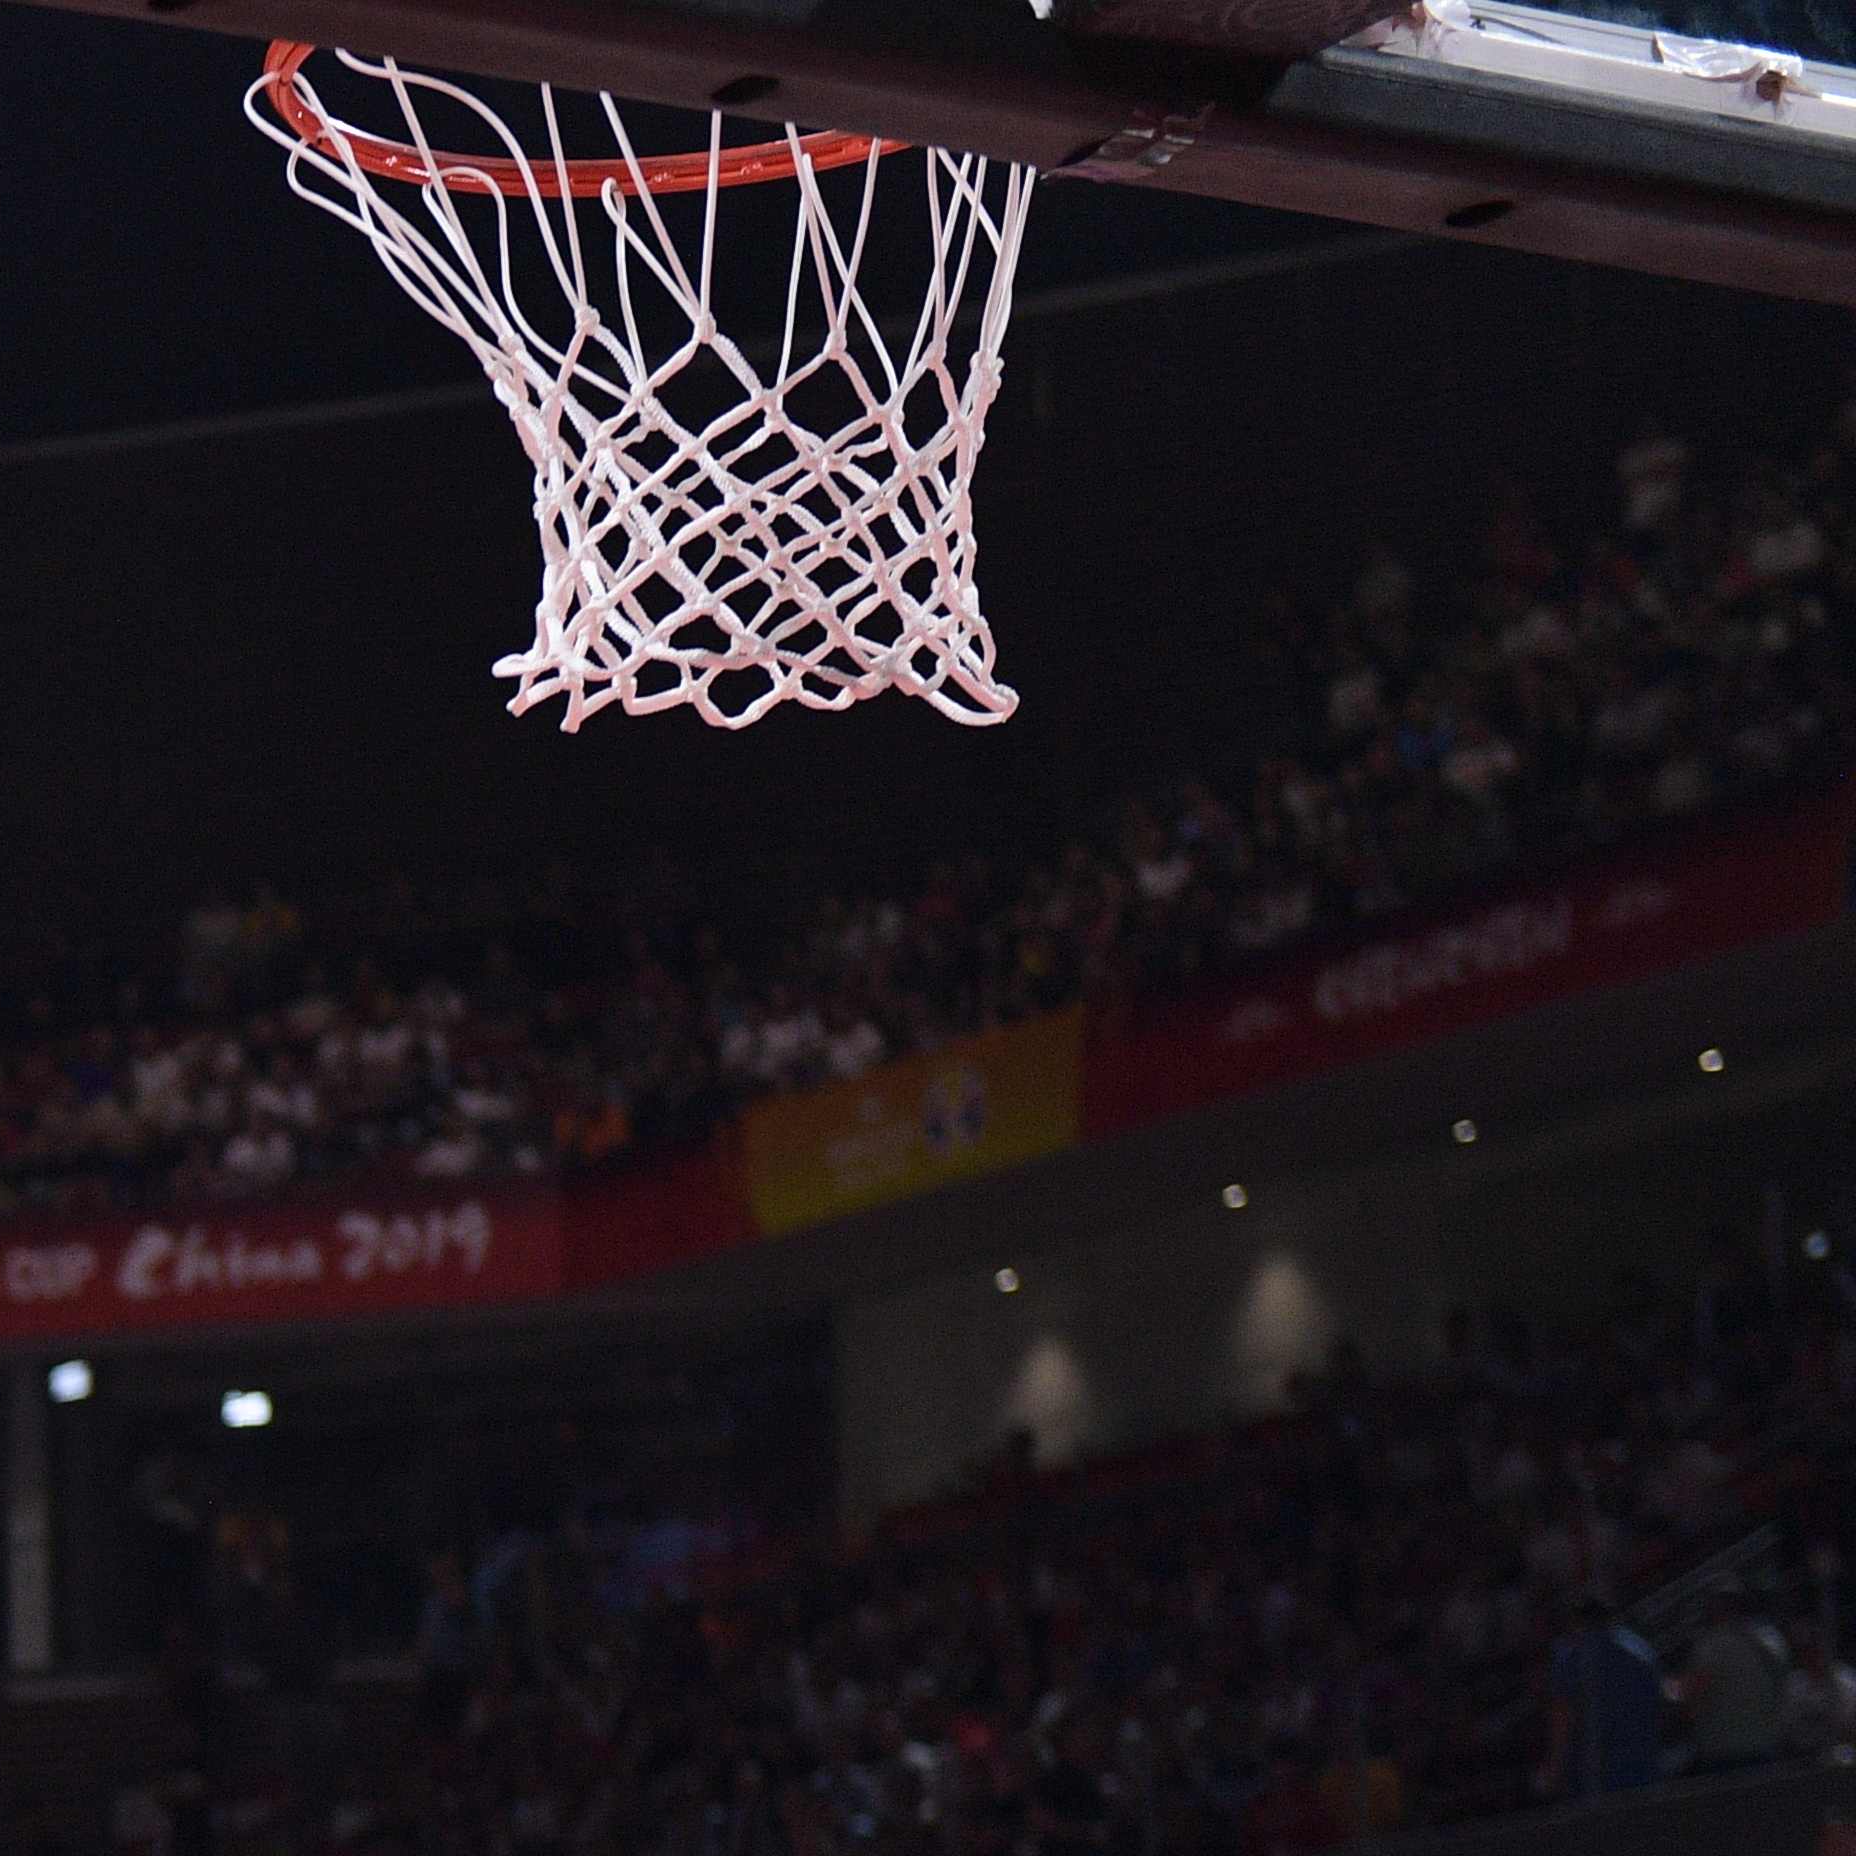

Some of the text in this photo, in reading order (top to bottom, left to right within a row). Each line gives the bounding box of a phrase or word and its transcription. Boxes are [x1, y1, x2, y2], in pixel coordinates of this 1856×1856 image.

[4, 1242, 97, 1302] CUP
[116, 1222, 322, 1302] China
[336, 1202, 491, 1280] 2019
